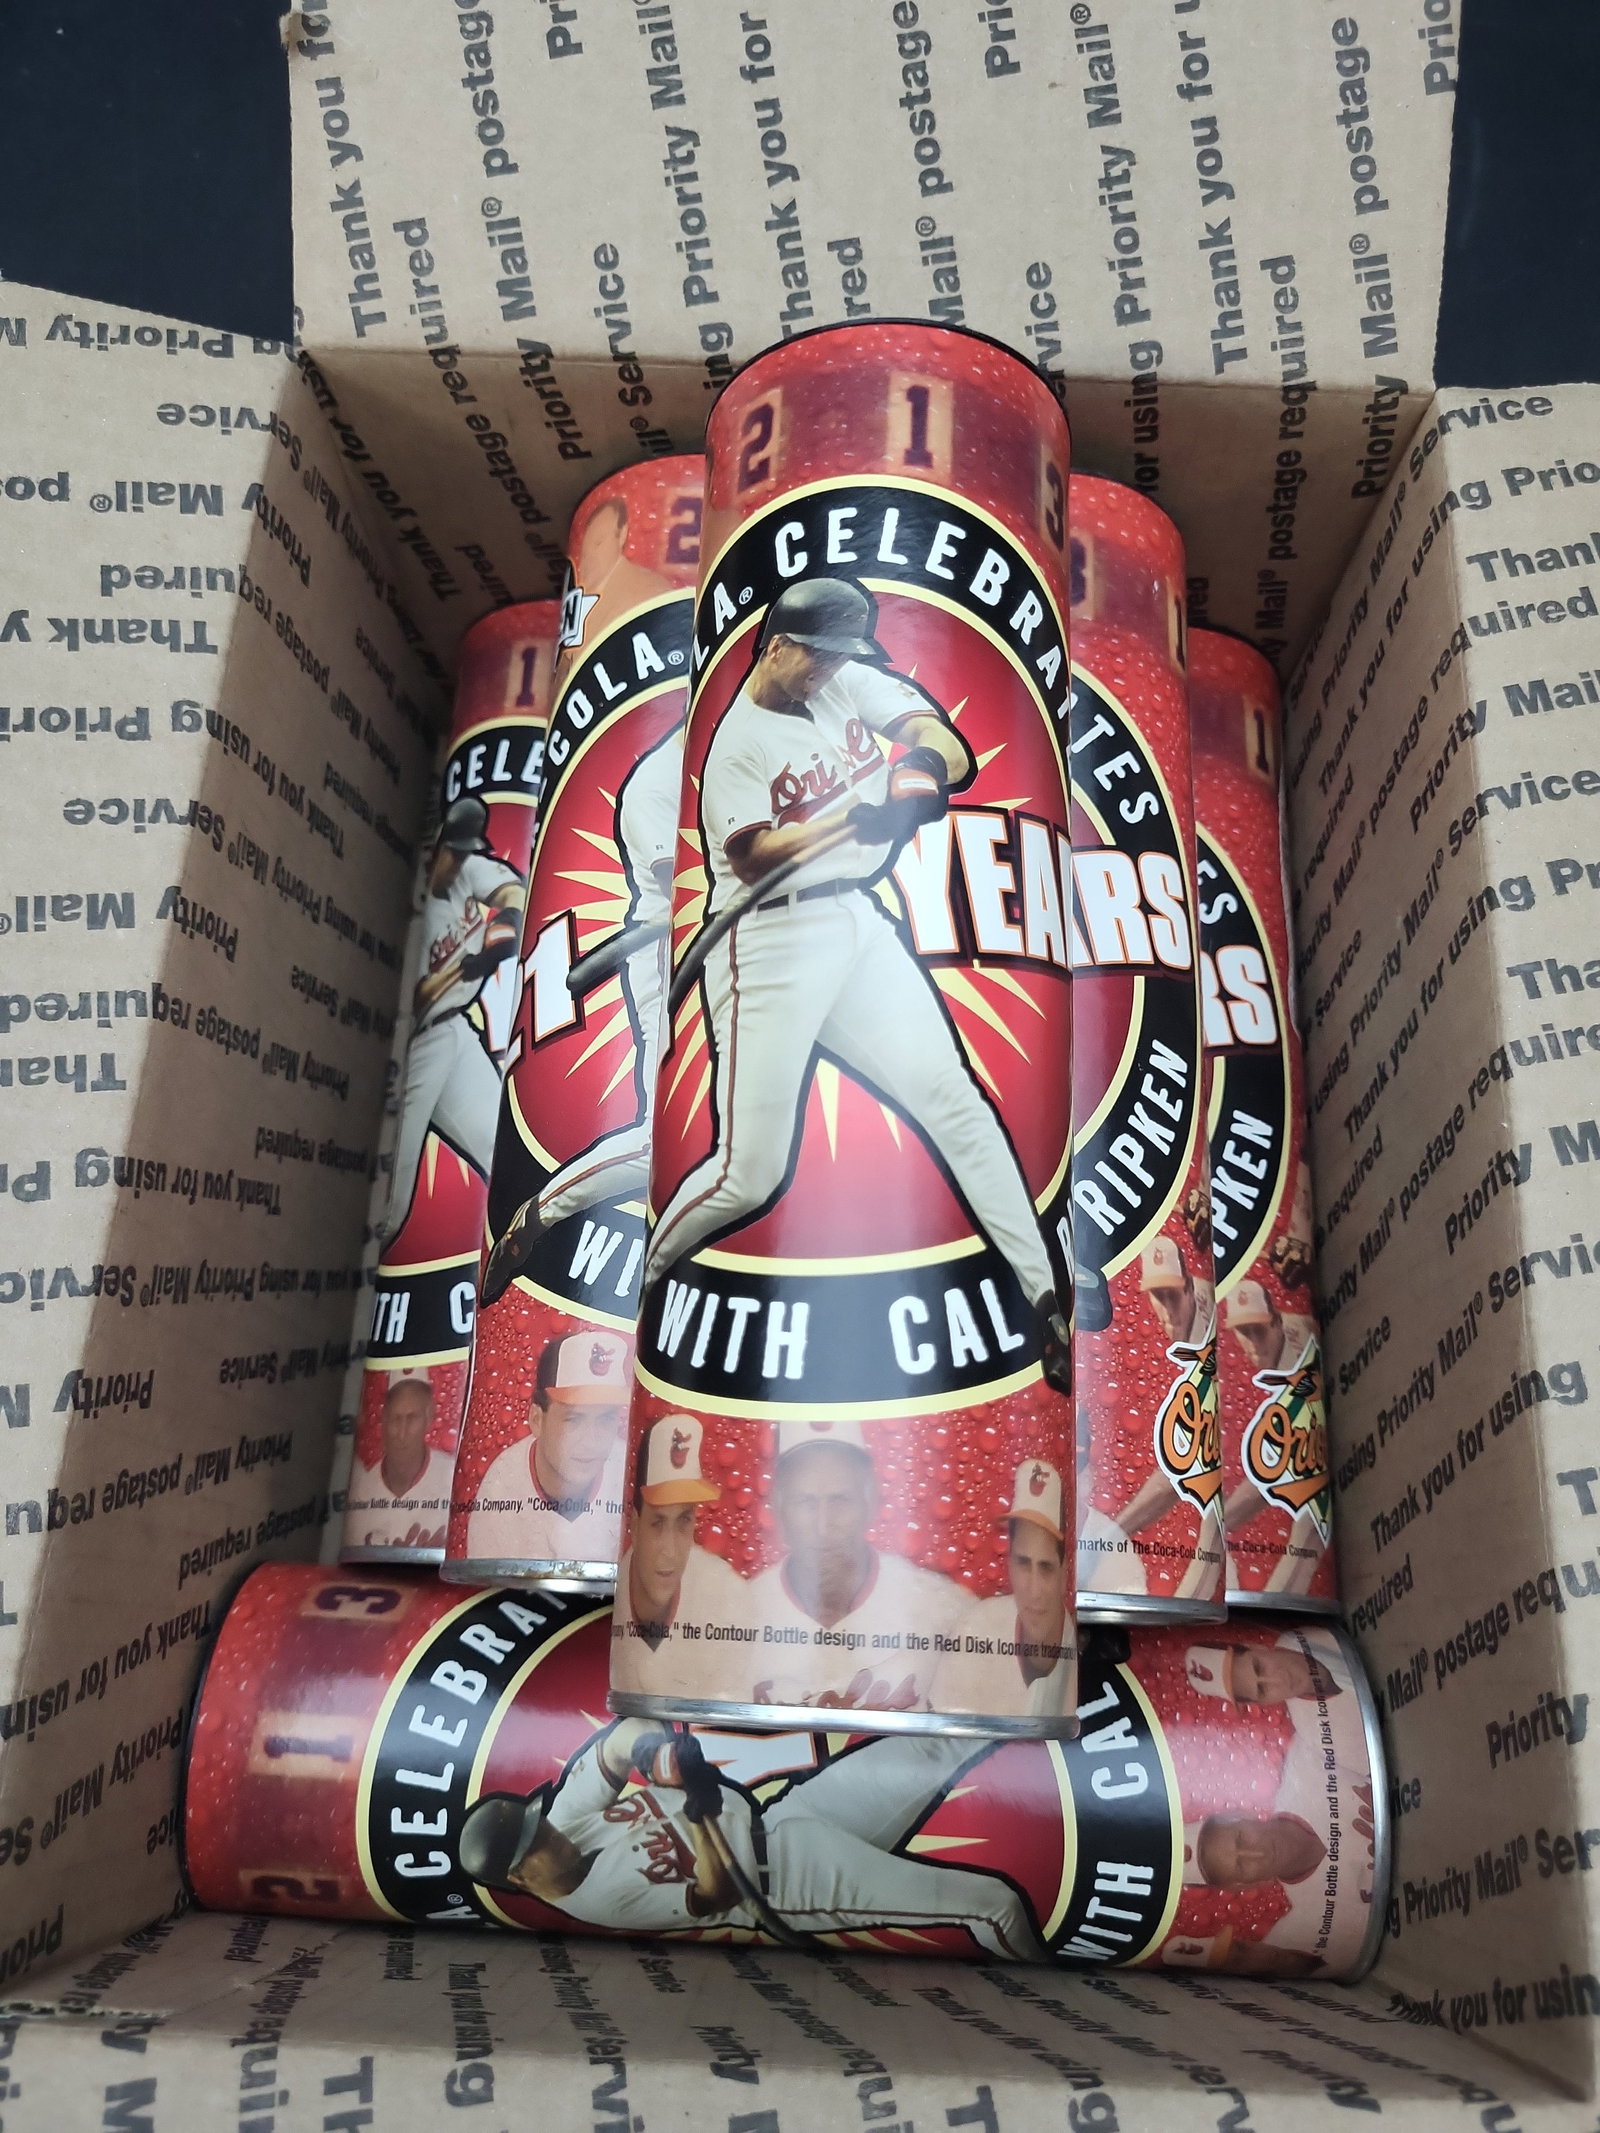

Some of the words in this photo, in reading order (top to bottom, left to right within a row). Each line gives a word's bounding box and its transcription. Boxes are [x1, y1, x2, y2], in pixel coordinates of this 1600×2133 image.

[739, 10, 775, 85] for
[1176, 30, 1213, 102] for
[316, 76, 364, 168] you
[893, 0, 954, 199] postage
[1330, 16, 1390, 216] postage
[754, 96, 800, 188] you
[1189, 115, 1236, 208] you
[662, 124, 720, 307] Priority
[1098, 144, 1152, 327] Priority
[330, 177, 388, 338] Thank
[1198, 216, 1248, 375] Thank
[45, 313, 234, 359] Priority
[393, 217, 477, 405] required
[593, 242, 653, 407] Service
[1260, 254, 1318, 441] required
[517, 338, 593, 461] Priority
[1121, 338, 1164, 445] using
[156, 403, 303, 472] Service
[466, 413, 552, 524] postage
[737, 402, 776, 493] 2
[903, 384, 934, 469] 1
[1352, 374, 1409, 499] Priority
[1410, 396, 1553, 483] Service
[240, 482, 312, 590] Priority
[1266, 449, 1308, 561] postage
[100, 563, 272, 625] required
[774, 507, 1070, 720] CELEBRA
[47, 616, 218, 655] Thank
[275, 611, 330, 694] postage
[1318, 704, 1360, 797] Thank
[1358, 639, 1386, 712] you
[1385, 577, 1410, 638] for
[1411, 477, 1493, 578] using
[513, 647, 538, 708] 1
[1369, 694, 1429, 835] postage
[1430, 585, 1599, 694] required
[172, 699, 251, 764] using
[1409, 698, 1488, 834] Priority
[253, 750, 277, 796] for
[278, 772, 306, 816] you
[63, 798, 226, 853] Service
[157, 885, 239, 963] Priority
[1349, 938, 1402, 1047] Priority
[1449, 769, 1600, 857] Service
[195, 1005, 262, 1060] postage
[1344, 1059, 1391, 1143] Thank
[1388, 1008, 1420, 1078] you
[1419, 956, 1445, 1016] for
[1447, 874, 1538, 966] using
[75, 1146, 167, 1200] using
[1074, 1039, 1188, 1236] RIPKEN
[1400, 1102, 1465, 1222] postage
[171, 1165, 200, 1205] for
[202, 1169, 235, 1202] you
[236, 1178, 282, 1217] Thank
[1326, 1123, 1384, 1235] required
[1445, 1141, 1533, 1255] Priority
[0, 1263, 137, 1312] Servic
[195, 1259, 256, 1302] Priority
[569, 1220, 643, 1298] WI
[656, 1279, 810, 1380] WITH
[888, 1278, 1025, 1376] CAL
[1338, 1315, 1393, 1396] Service
[53, 1369, 155, 1420] Priority
[1335, 1434, 1377, 1494] using
[1376, 1360, 1436, 1447] Priority
[101, 1453, 183, 1514] postage
[1369, 1480, 1421, 1554] Thank
[1421, 1450, 1455, 1513] you
[1456, 1416, 1485, 1471] for
[1489, 1359, 1588, 1438] using
[421, 1498, 439, 1510] and
[605, 1500, 625, 1514] the
[178, 1524, 253, 1591] required
[1117, 1539, 1129, 1553] of
[1131, 1540, 1151, 1555] The
[1153, 1543, 1197, 1559] Coca-Cola
[156, 1600, 214, 1660] Thank
[317, 1585, 402, 1614] 3
[1351, 1553, 1415, 1637] required
[76, 1656, 109, 1700] for
[114, 1622, 153, 1680] you
[682, 1622, 701, 1640] the
[705, 1624, 758, 1643] Contour
[763, 1625, 808, 1645] Bottle
[813, 1627, 866, 1651] design
[871, 1631, 901, 1649] and
[905, 1632, 930, 1651] the
[934, 1634, 961, 1652] Red
[965, 1636, 994, 1655] Disk
[997, 1638, 1021, 1656] Icon
[1434, 1598, 1511, 1691] postage
[390, 1592, 568, 1880] CELEBRA
[1076, 1680, 1150, 1801] CAL
[1317, 1692, 1329, 1718] Icon
[1319, 1720, 1333, 1747] Disk
[1486, 1690, 1590, 1770] Priority
[1324, 1748, 1336, 1770] Red
[1326, 1773, 1338, 1794] the
[1327, 1822, 1342, 1862] design
[1328, 1797, 1339, 1819] and
[1056, 1860, 1155, 1962] WITH
[1318, 1899, 1335, 1935] Contour
[1325, 1864, 1338, 1897] Bottle
[1403, 1866, 1472, 1924] Priority
[1316, 1934, 1328, 1949] the
[1450, 1990, 1488, 2035] you
[1493, 1976, 1528, 2026] for
